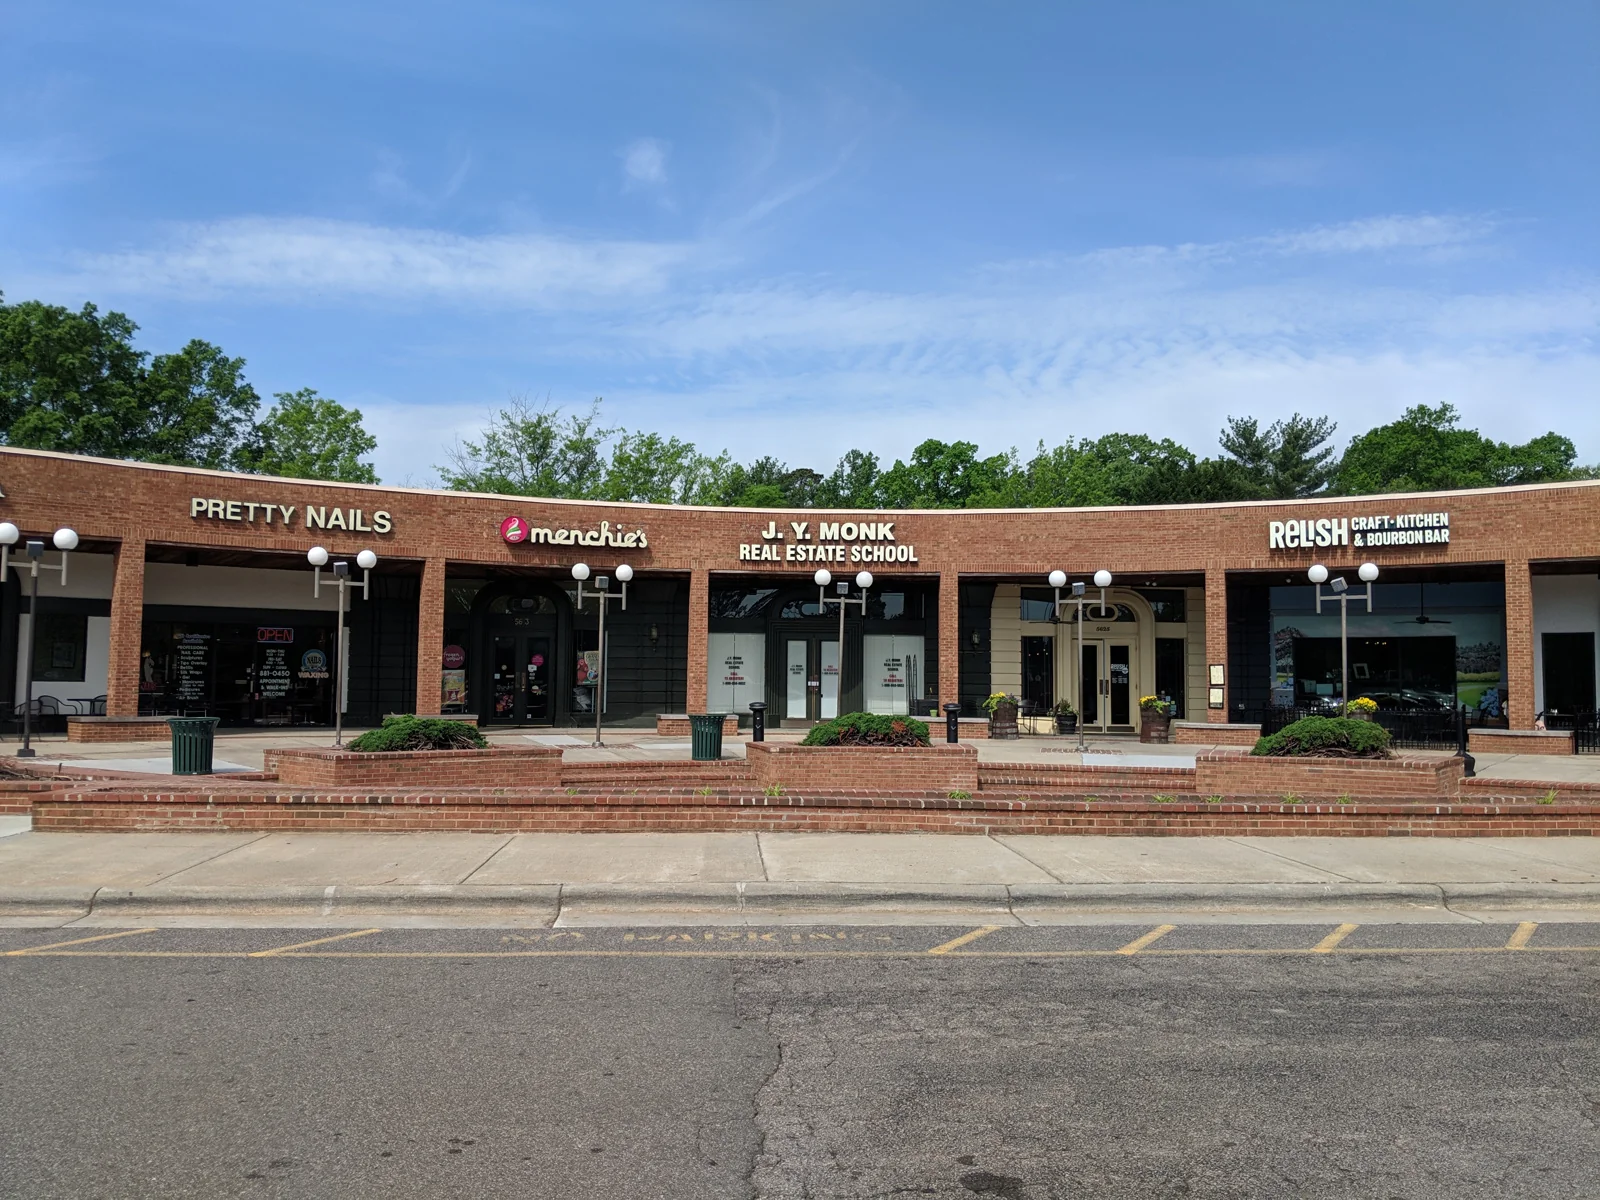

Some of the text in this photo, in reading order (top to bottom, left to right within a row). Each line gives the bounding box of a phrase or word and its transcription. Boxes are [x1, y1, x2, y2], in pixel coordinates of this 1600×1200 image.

[190, 497, 392, 534] PRETTY NAILS
[531, 520, 648, 548] menchie's
[762, 521, 895, 541] J. Y. MONK
[1353, 529, 1450, 547] & BOURBON BAR
[740, 543, 918, 562] REAL ESTATE SCHOOL
[257, 628, 292, 641] OPEN
[298, 671, 330, 679] WAXING
